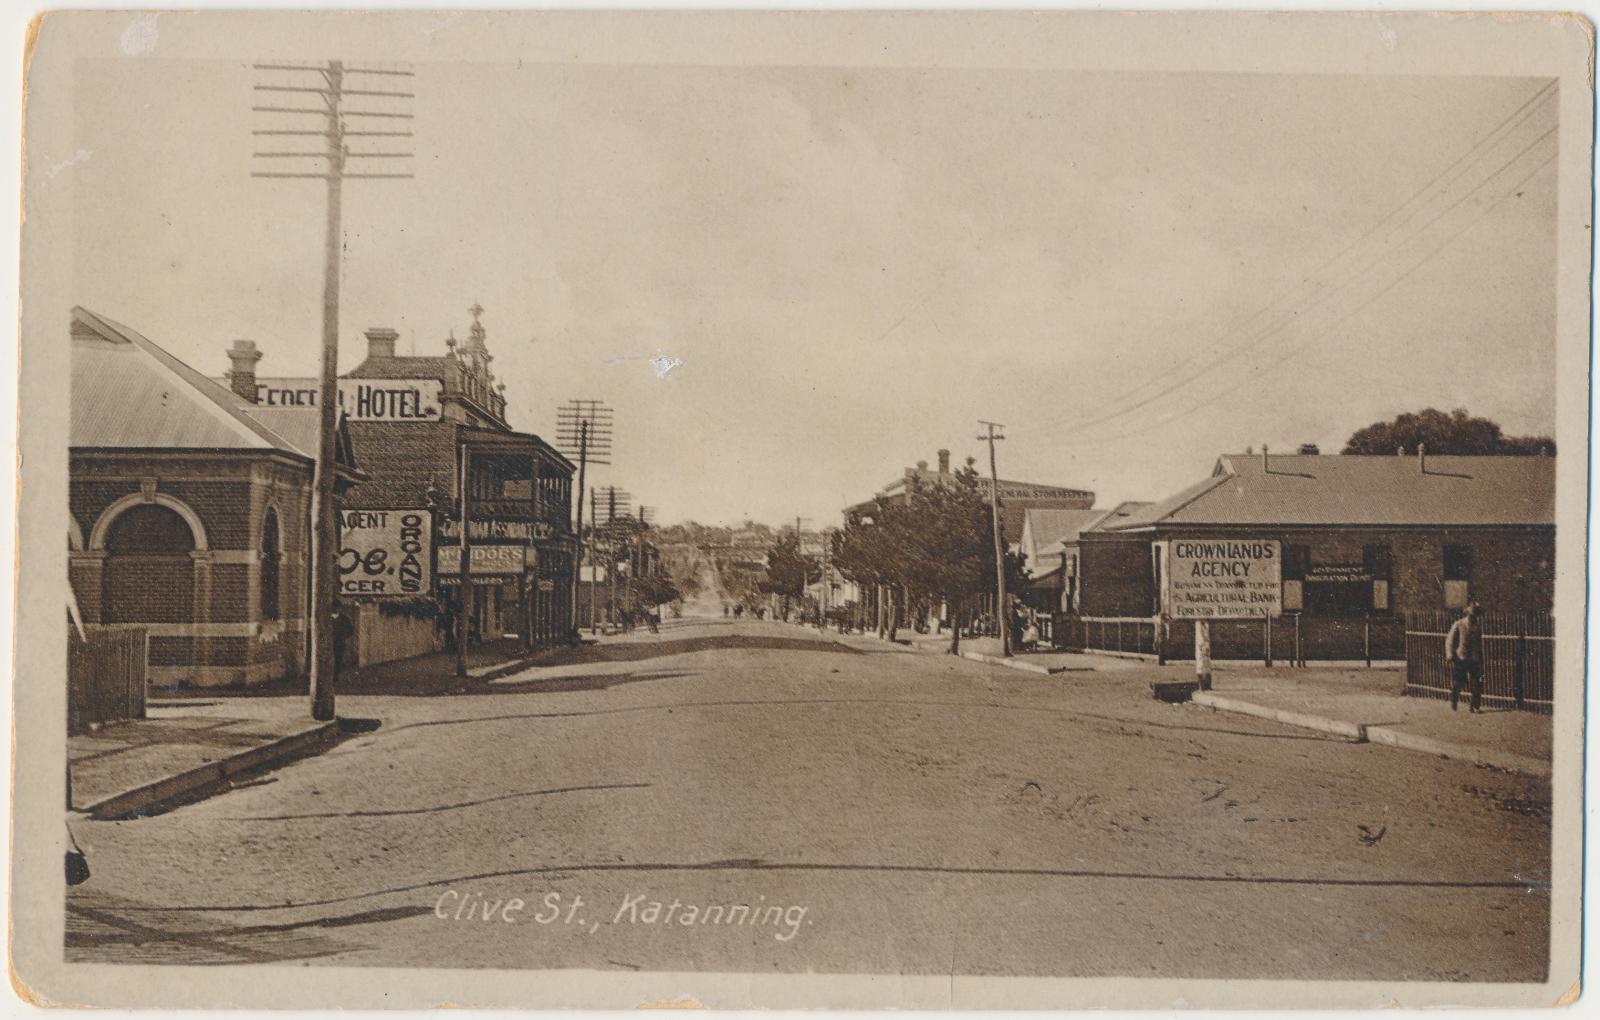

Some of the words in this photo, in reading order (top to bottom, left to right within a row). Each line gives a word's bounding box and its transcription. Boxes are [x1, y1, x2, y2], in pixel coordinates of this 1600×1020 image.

[357, 385, 427, 418] HOTEL
[400, 514, 422, 593] ORGANS
[1191, 561, 1251, 577] AGENCY
